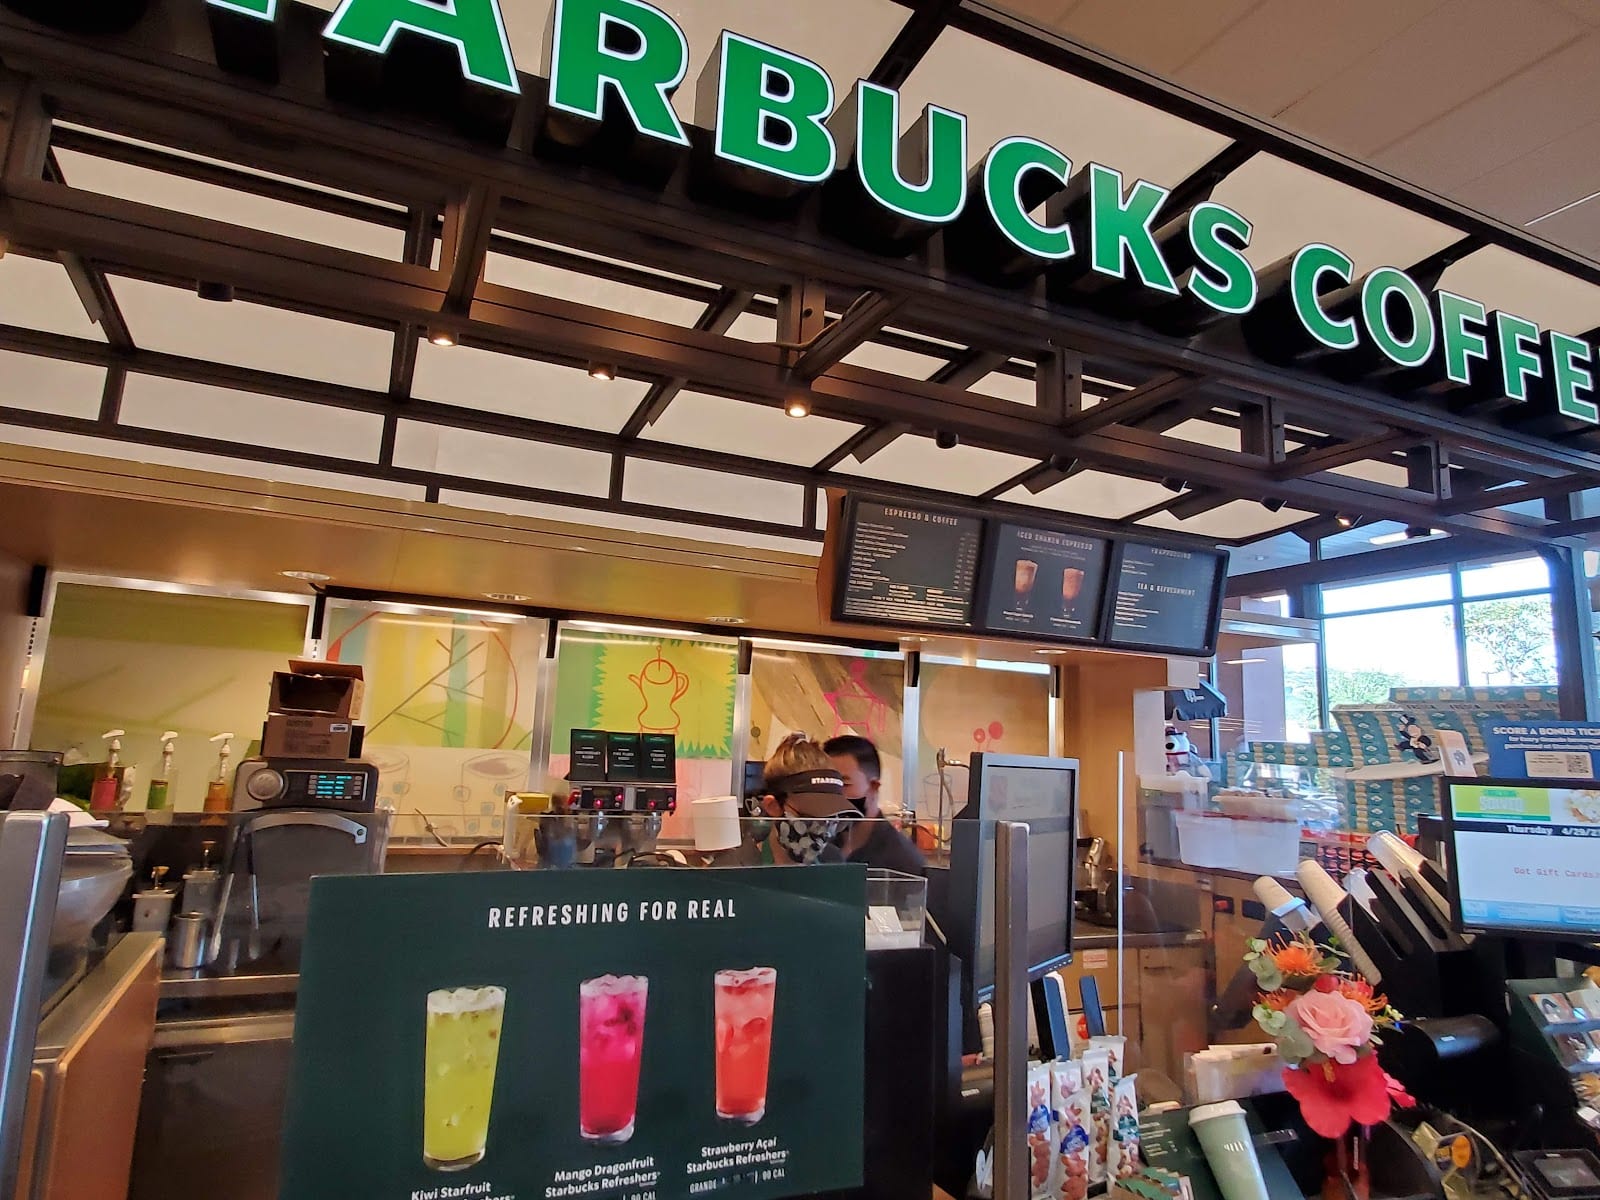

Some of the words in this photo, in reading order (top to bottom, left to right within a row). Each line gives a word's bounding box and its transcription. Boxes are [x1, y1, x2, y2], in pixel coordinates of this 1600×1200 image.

[206, 0, 1258, 315] ARBUCKS
[1291, 243, 1600, 424] COFFE
[884, 507, 921, 521] ESPRESSO
[932, 515, 958, 526] COFFEE
[1017, 530, 1033, 540] ICED
[1062, 539, 1093, 551] ESPRESSO
[1137, 582, 1148, 590] TEA
[1493, 726, 1528, 735] SCORE
[1530, 727, 1538, 735] A
[1539, 727, 1577, 736] BONUS
[1506, 825, 1553, 836] Thursday
[488, 902, 629, 928] REFRESHING
[639, 901, 677, 921] FOR
[688, 898, 736, 920] REAL
[701, 1140, 754, 1158] Strawberry
[554, 1167, 592, 1183] Mango
[594, 1155, 655, 1176] Dragonfruit
[686, 1156, 734, 1175] Starbucks
[735, 1150, 787, 1166] Refreshers
[411, 1187, 438, 1200] Kiwi
[440, 1181, 492, 1199] Starfruit
[545, 1180, 600, 1199] Starbucks
[601, 1171, 659, 1189] Refreshers
[689, 1178, 717, 1194] GRANDE
